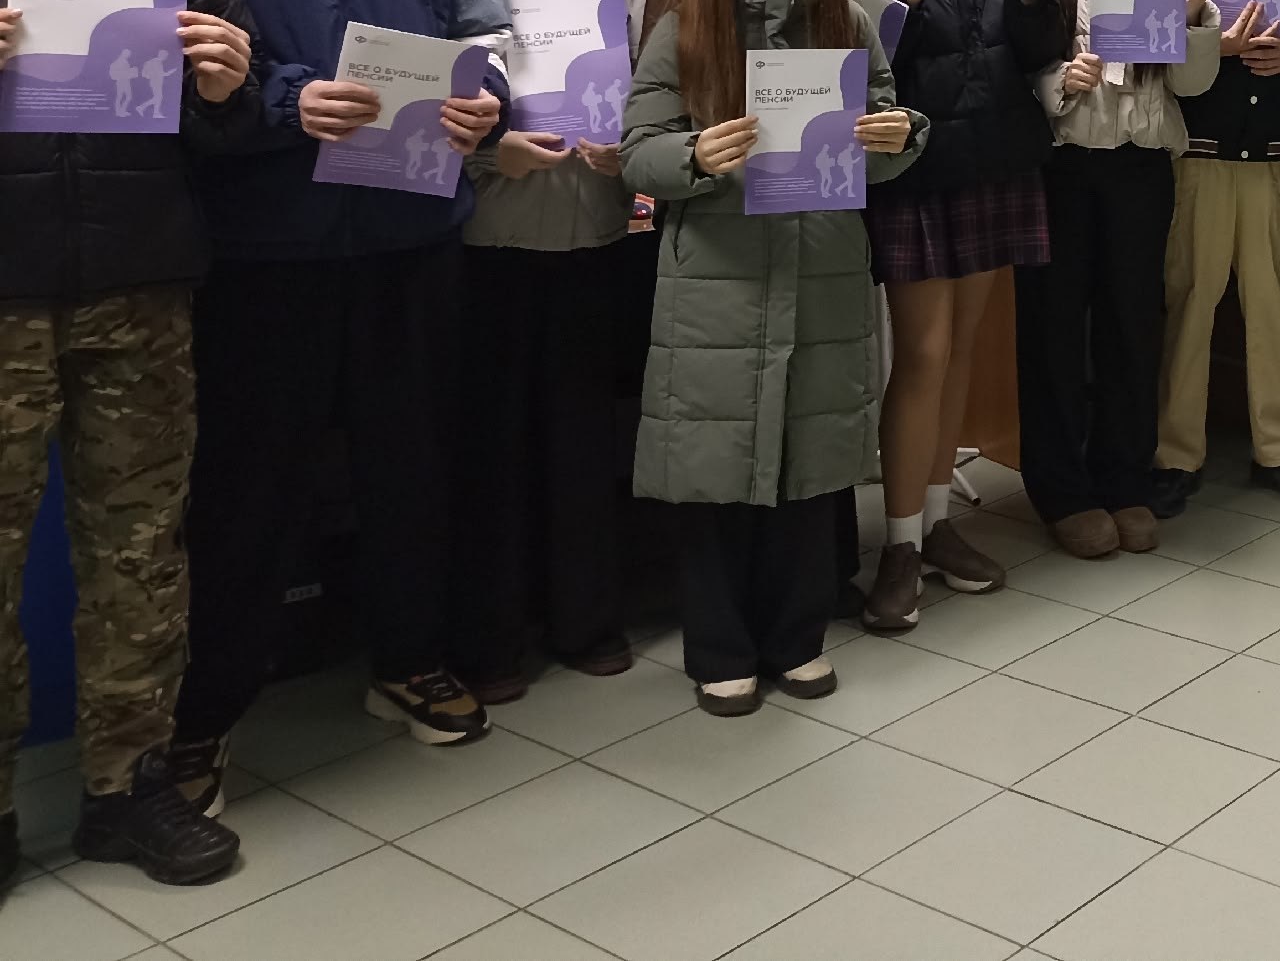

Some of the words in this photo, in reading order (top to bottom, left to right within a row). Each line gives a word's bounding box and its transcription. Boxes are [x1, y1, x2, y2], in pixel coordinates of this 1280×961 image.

[544, 26, 590, 38] БУДУЩЕЙ
[513, 40, 553, 48] ПЕНСИИ
[346, 70, 393, 82] ПЕНСИИ
[348, 63, 369, 72] ВСЕ
[384, 67, 440, 82] БУДУЩЕЙ
[786, 87, 831, 96] БУДУЩЕЙ
